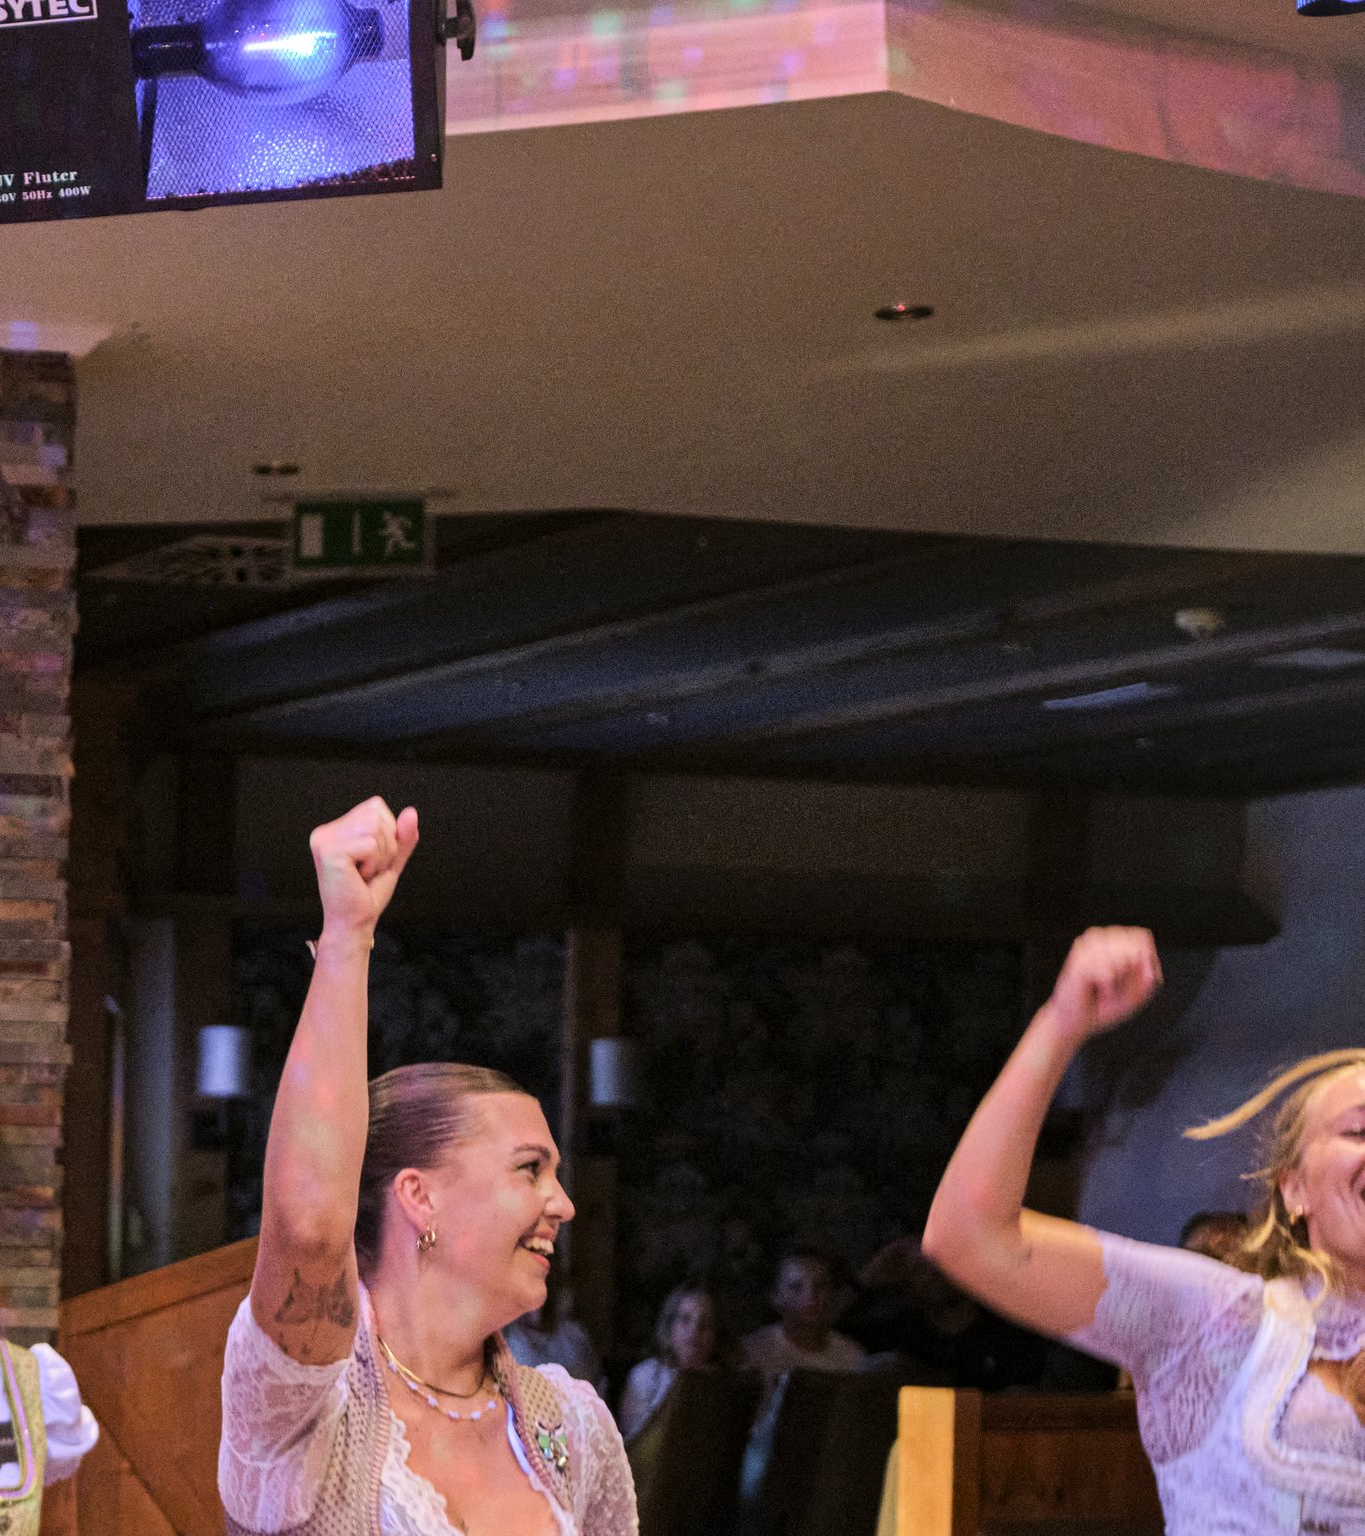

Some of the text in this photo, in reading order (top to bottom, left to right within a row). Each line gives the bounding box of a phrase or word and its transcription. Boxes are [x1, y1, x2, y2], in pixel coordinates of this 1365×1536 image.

[23, 170, 78, 185] Fluter
[21, 189, 54, 201] 50Hz
[58, 185, 92, 198] 400W
